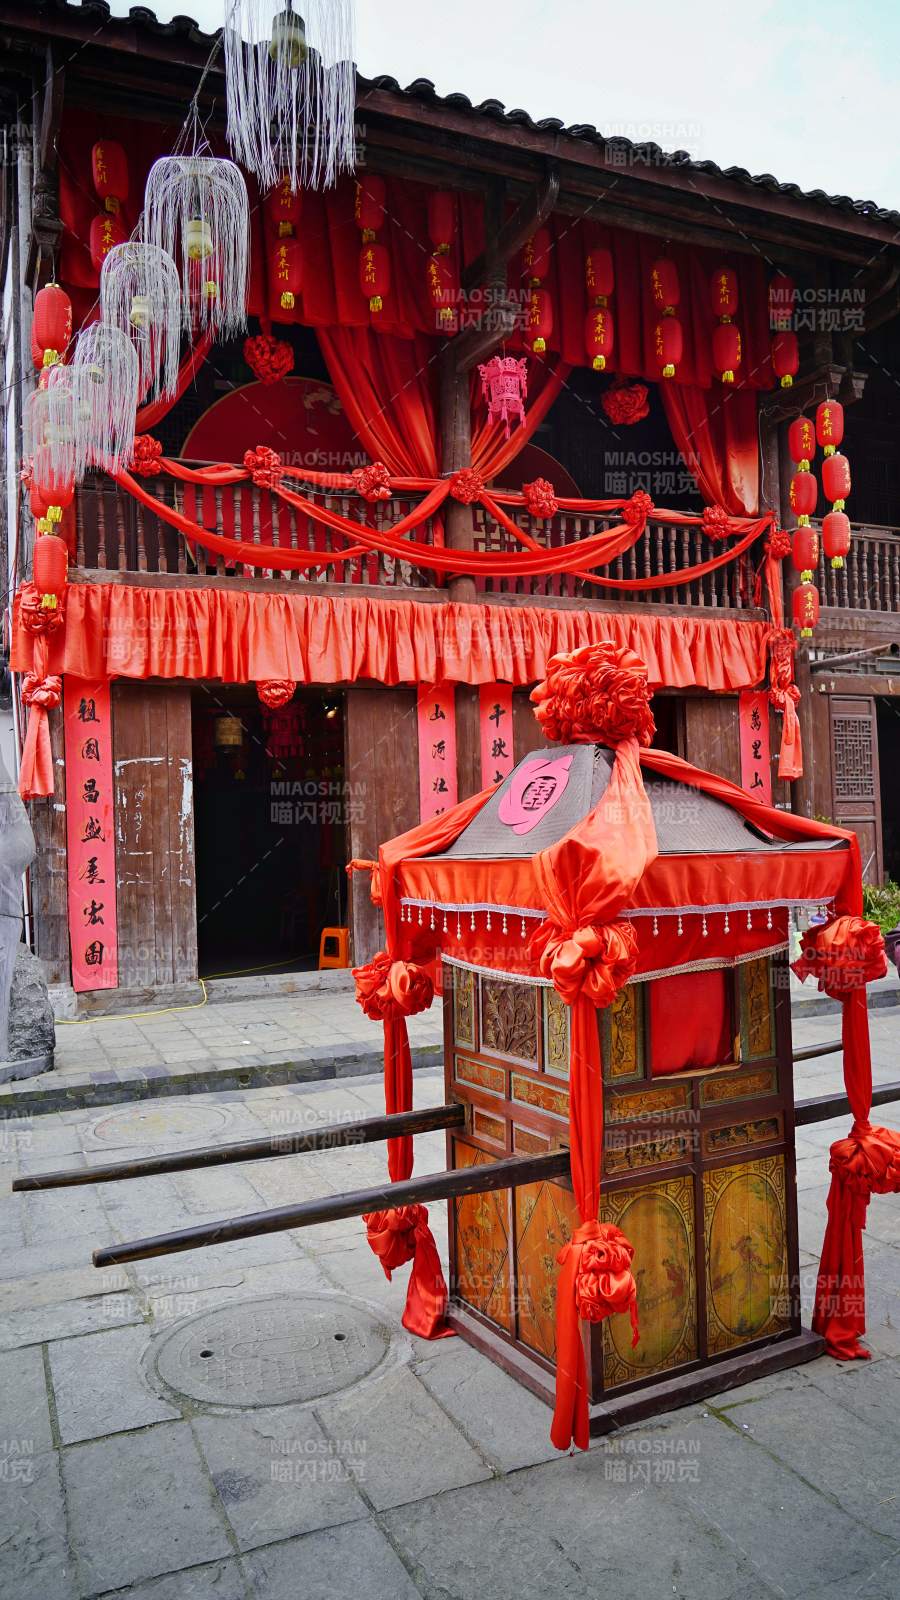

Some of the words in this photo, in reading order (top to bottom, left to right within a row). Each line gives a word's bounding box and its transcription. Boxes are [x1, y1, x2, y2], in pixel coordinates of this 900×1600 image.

[276, 245, 290, 281] 青木川
[363, 250, 377, 284] 青木川
[719, 274, 730, 305] 青木川
[593, 312, 605, 344] 青木川
[800, 422, 812, 451] 青木川
[821, 407, 833, 436] 青木川
[803, 591, 815, 621] 青木川
